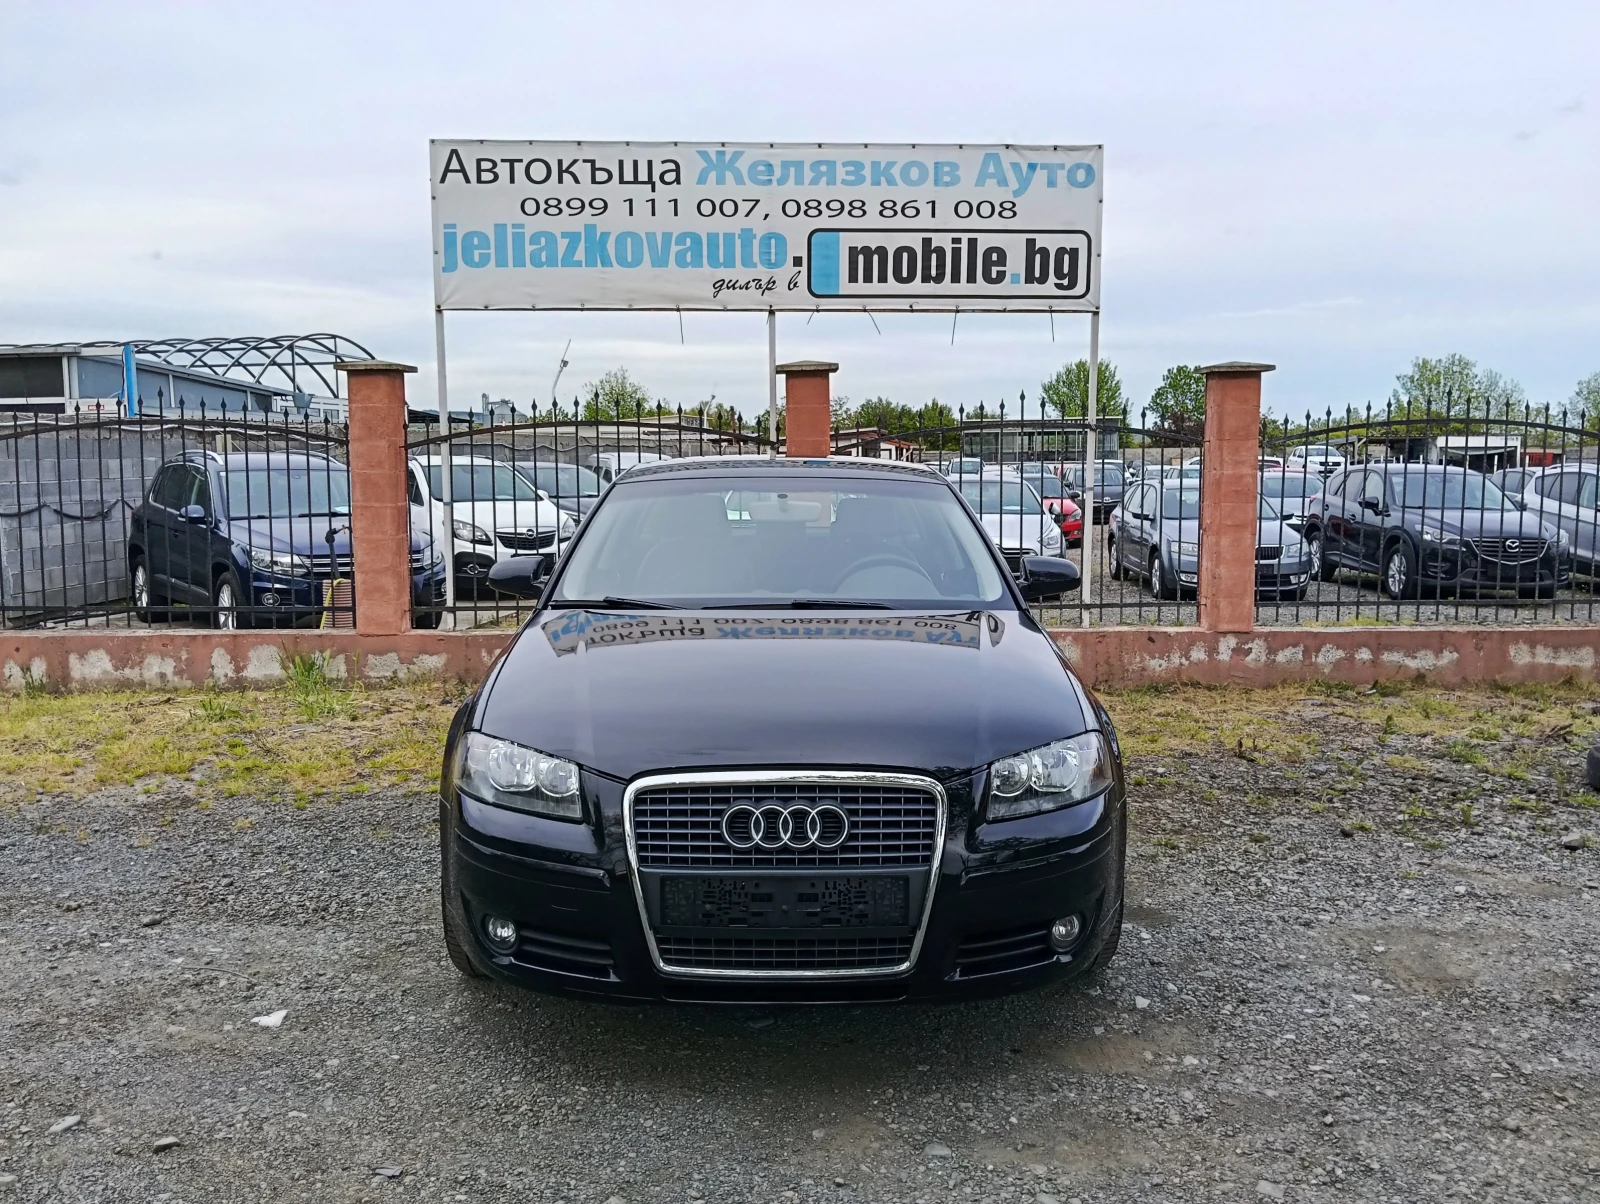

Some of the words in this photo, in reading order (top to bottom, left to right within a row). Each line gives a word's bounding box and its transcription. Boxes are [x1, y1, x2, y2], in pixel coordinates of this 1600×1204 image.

[439, 149, 682, 193] Автокъща
[695, 150, 961, 188] Желязков
[974, 153, 1096, 199] Ауто
[520, 197, 609, 217] 0899
[623, 198, 679, 217] 111
[696, 198, 770, 221] 007,
[781, 199, 867, 219] 0898
[878, 200, 936, 219] 861
[954, 200, 1018, 219] 008
[441, 223, 803, 273] jeliazkovauto.
[848, 237, 1080, 291] mobile.bg
[712, 275, 778, 298] дилър
